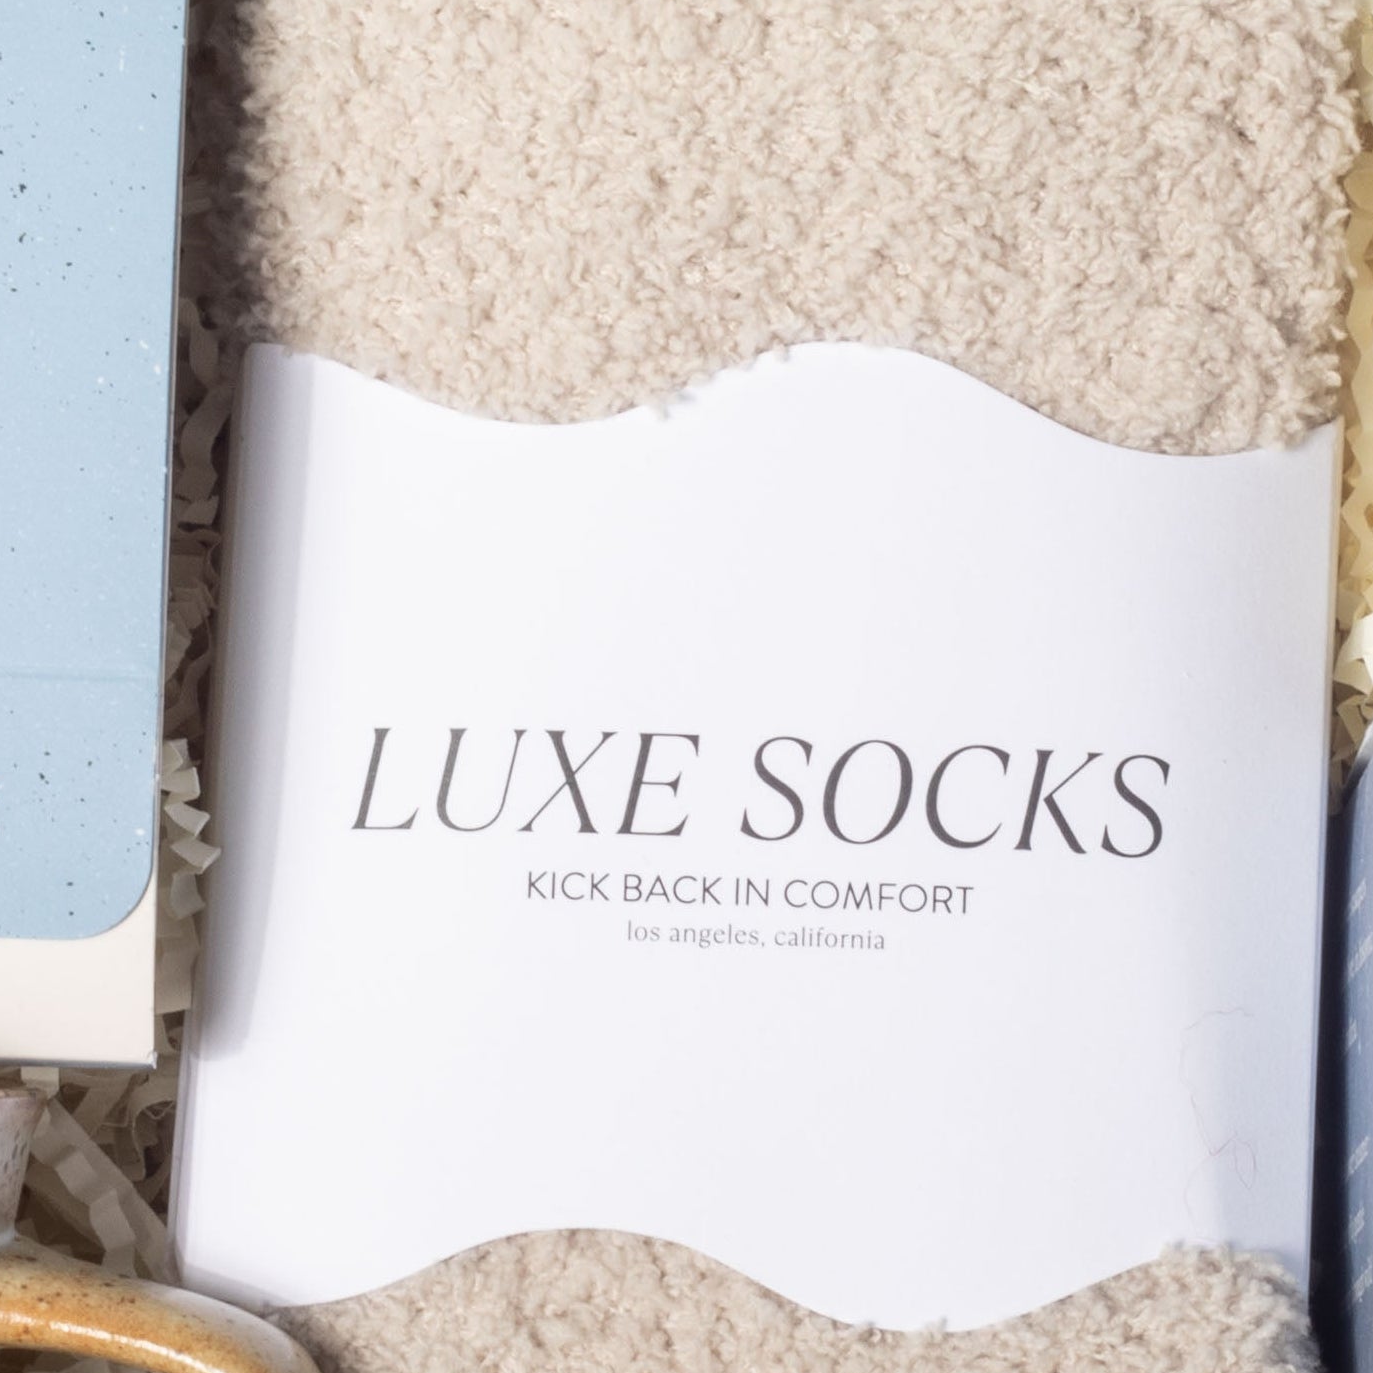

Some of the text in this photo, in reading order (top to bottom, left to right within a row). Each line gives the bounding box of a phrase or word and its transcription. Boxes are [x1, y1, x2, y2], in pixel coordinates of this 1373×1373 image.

[351, 728, 1171, 858] LUXE SOCKS
[528, 871, 974, 913] KICK BACK IN COMFORT
[628, 921, 884, 949] los angeles, california
